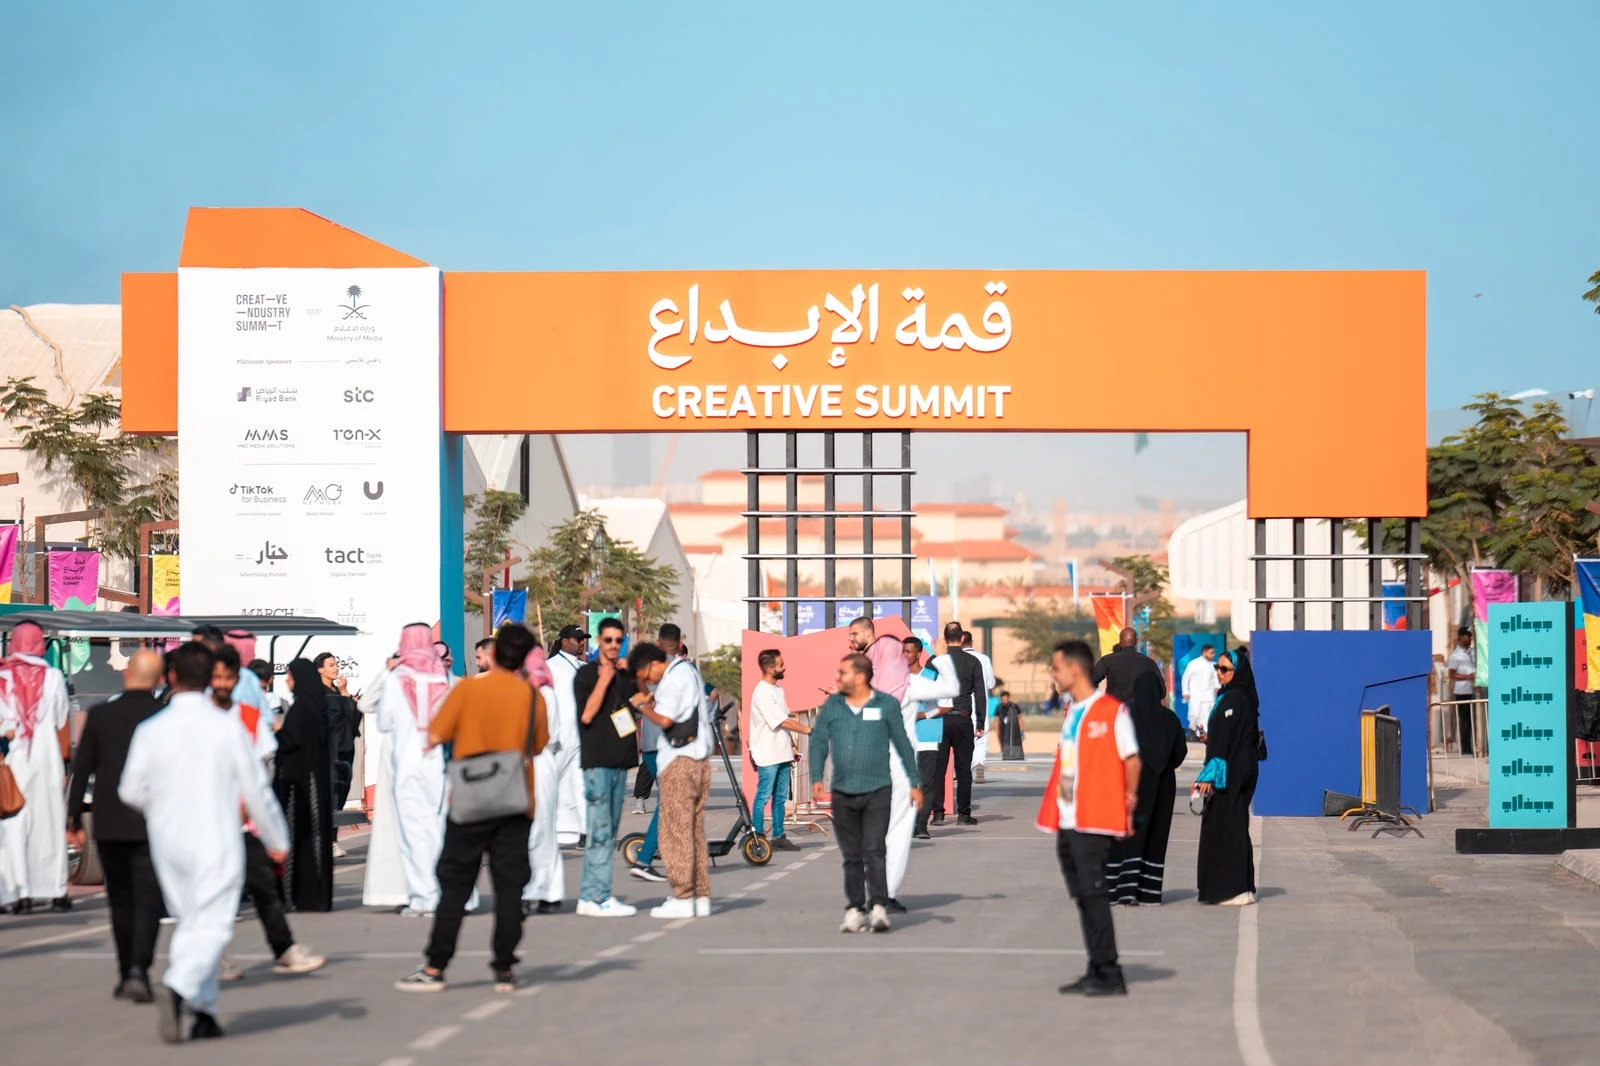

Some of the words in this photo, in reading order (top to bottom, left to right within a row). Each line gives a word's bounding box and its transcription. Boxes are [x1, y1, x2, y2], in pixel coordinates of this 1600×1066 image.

[895, 280, 1013, 352] قمة
[647, 282, 880, 371] الإبداع
[326, 335, 353, 343] Ministry
[255, 394, 277, 404] Riyad
[278, 394, 298, 403] Bank
[343, 386, 374, 403] stc
[652, 384, 843, 419] CREATIVE
[853, 384, 1012, 419] SUMMIT
[253, 496, 287, 504] Business
[324, 547, 365, 564] tact
